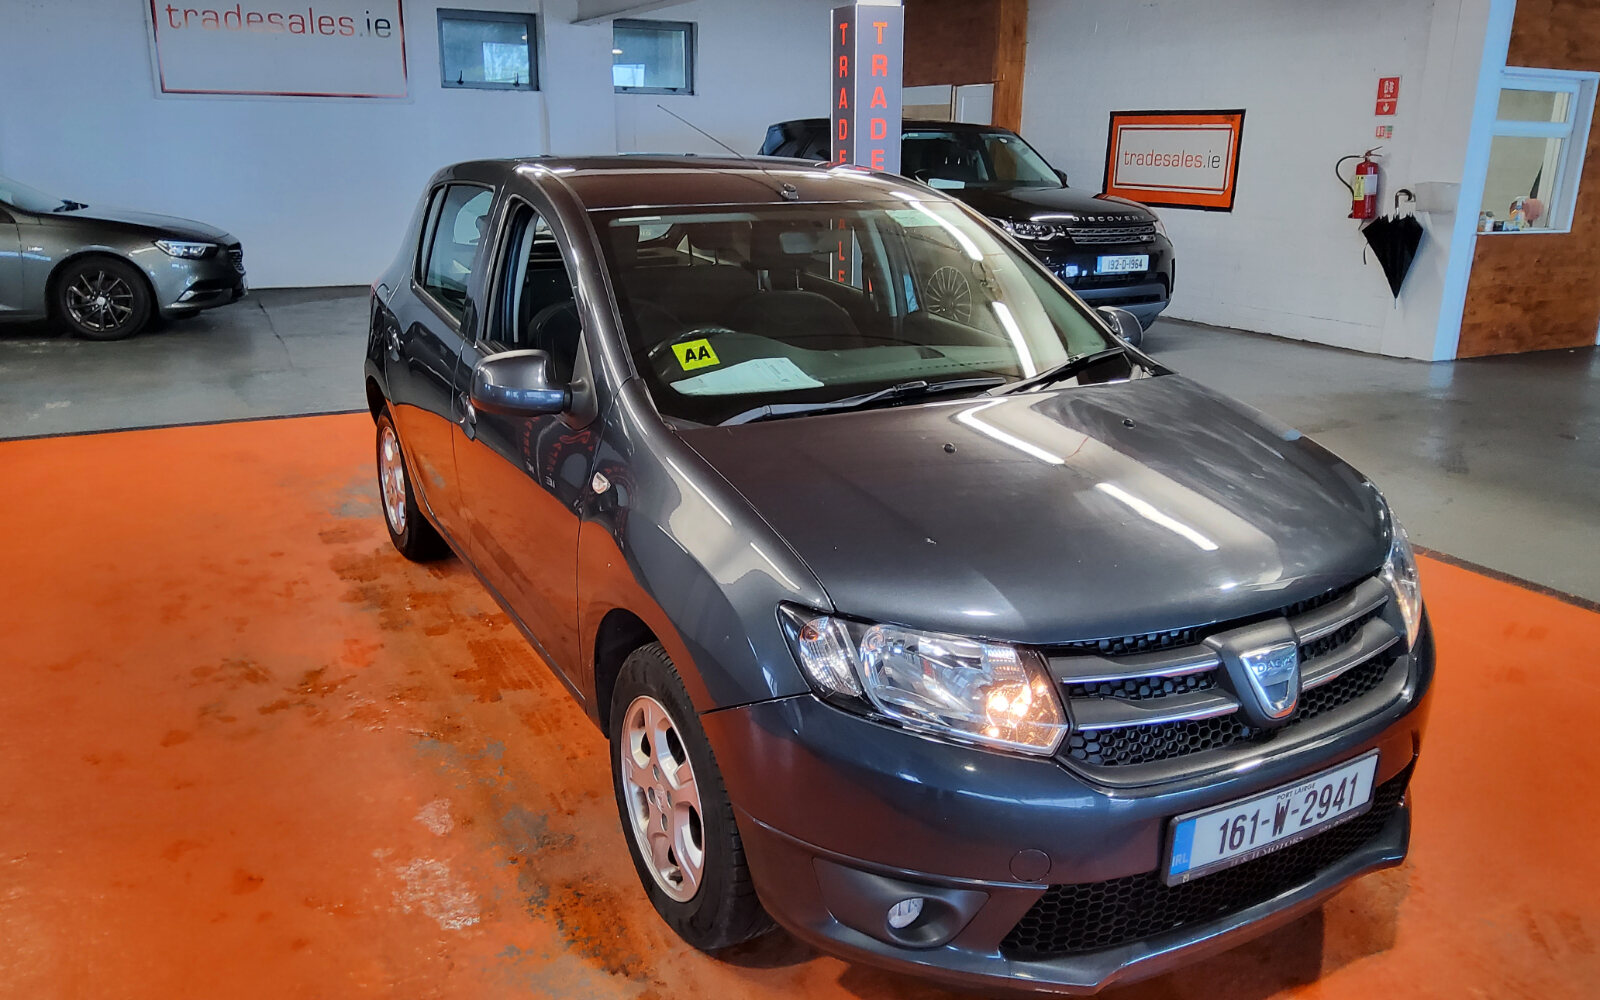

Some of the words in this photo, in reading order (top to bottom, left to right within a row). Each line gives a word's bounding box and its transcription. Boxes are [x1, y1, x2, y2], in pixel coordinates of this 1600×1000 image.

[165, 3, 392, 39] tradesales.ie
[870, 21, 888, 171] TRADE
[1124, 149, 1221, 169] tradesales.ie
[1107, 258, 1143, 270] 192-D-1964
[684, 345, 711, 363] AA
[1218, 772, 1359, 855] 161-W-2941
[1171, 853, 1189, 867] IRL
